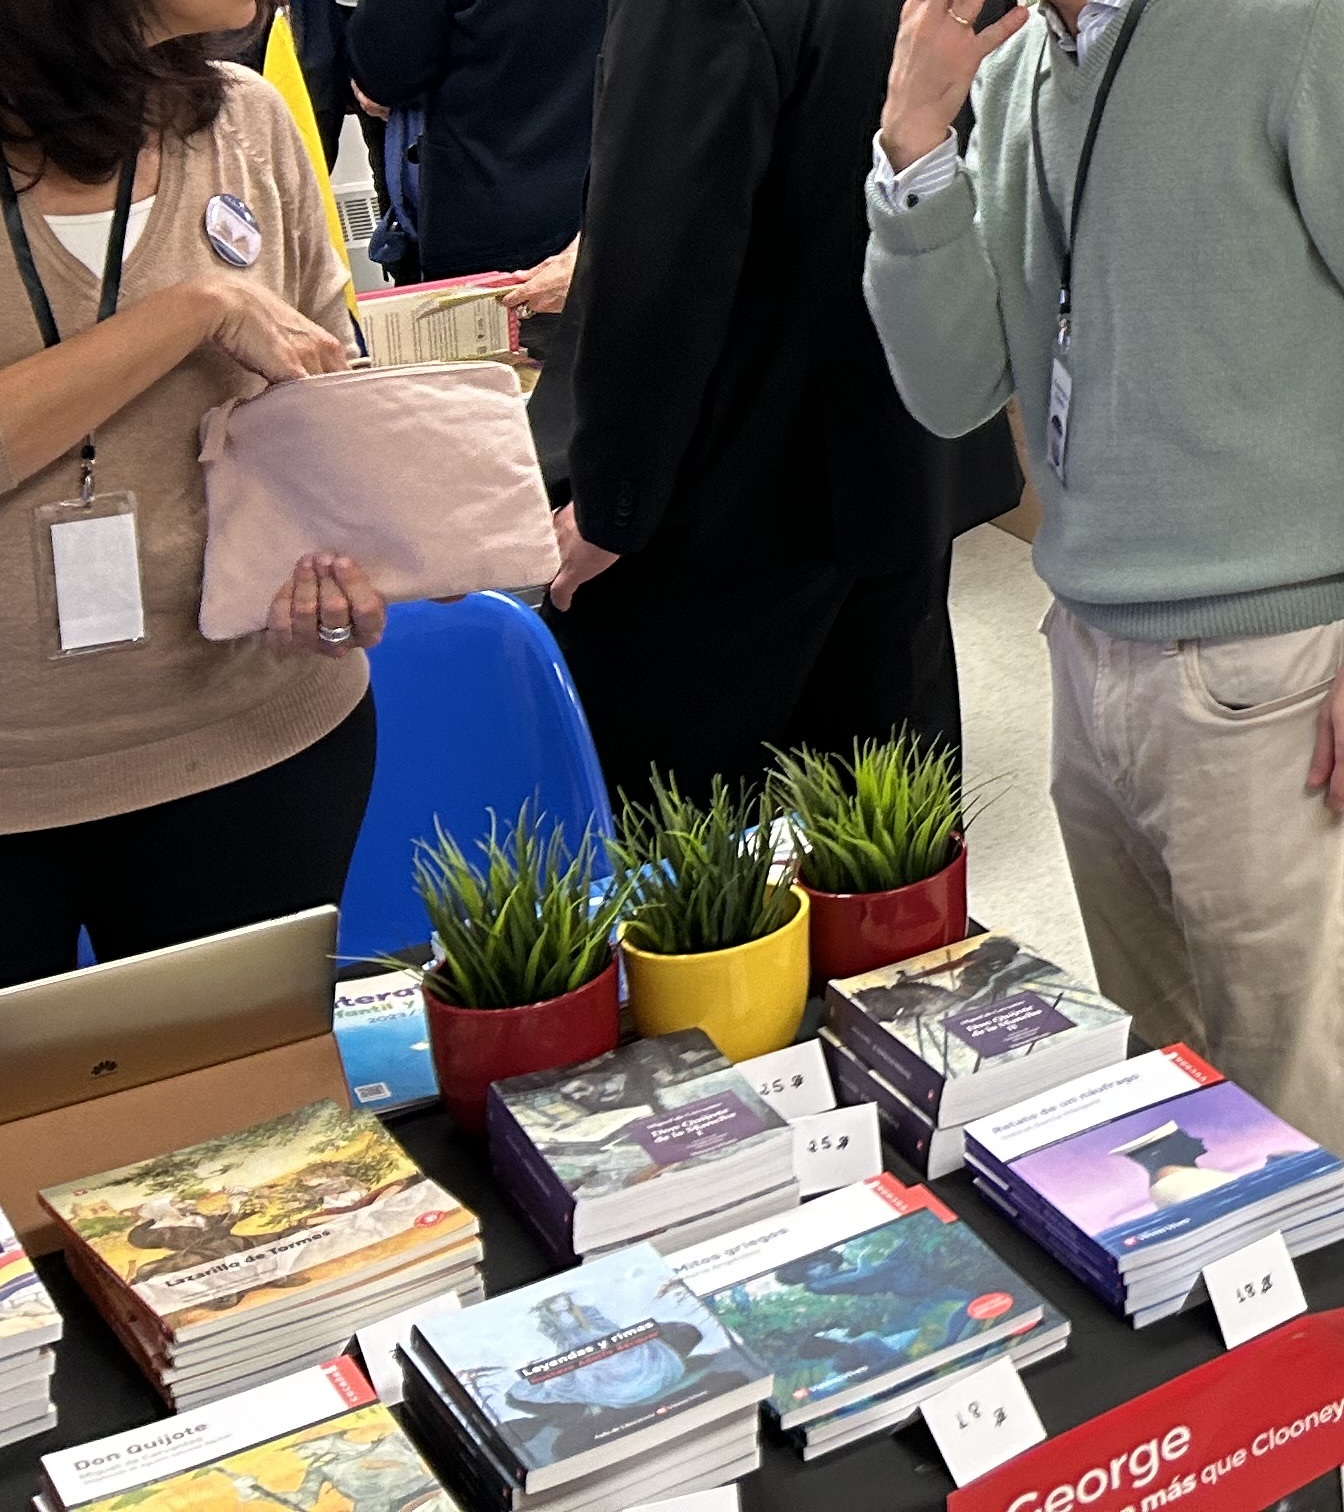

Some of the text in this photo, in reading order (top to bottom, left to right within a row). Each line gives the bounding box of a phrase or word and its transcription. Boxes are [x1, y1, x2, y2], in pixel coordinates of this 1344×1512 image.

[165, 1229, 332, 1288] Lazarillo de Tormes
[521, 1321, 655, 1377] Leyendas y rimas
[73, 1422, 208, 1472] Don Quijote
[1140, 1473, 1198, 1512] más
[1200, 1446, 1248, 1486] que
